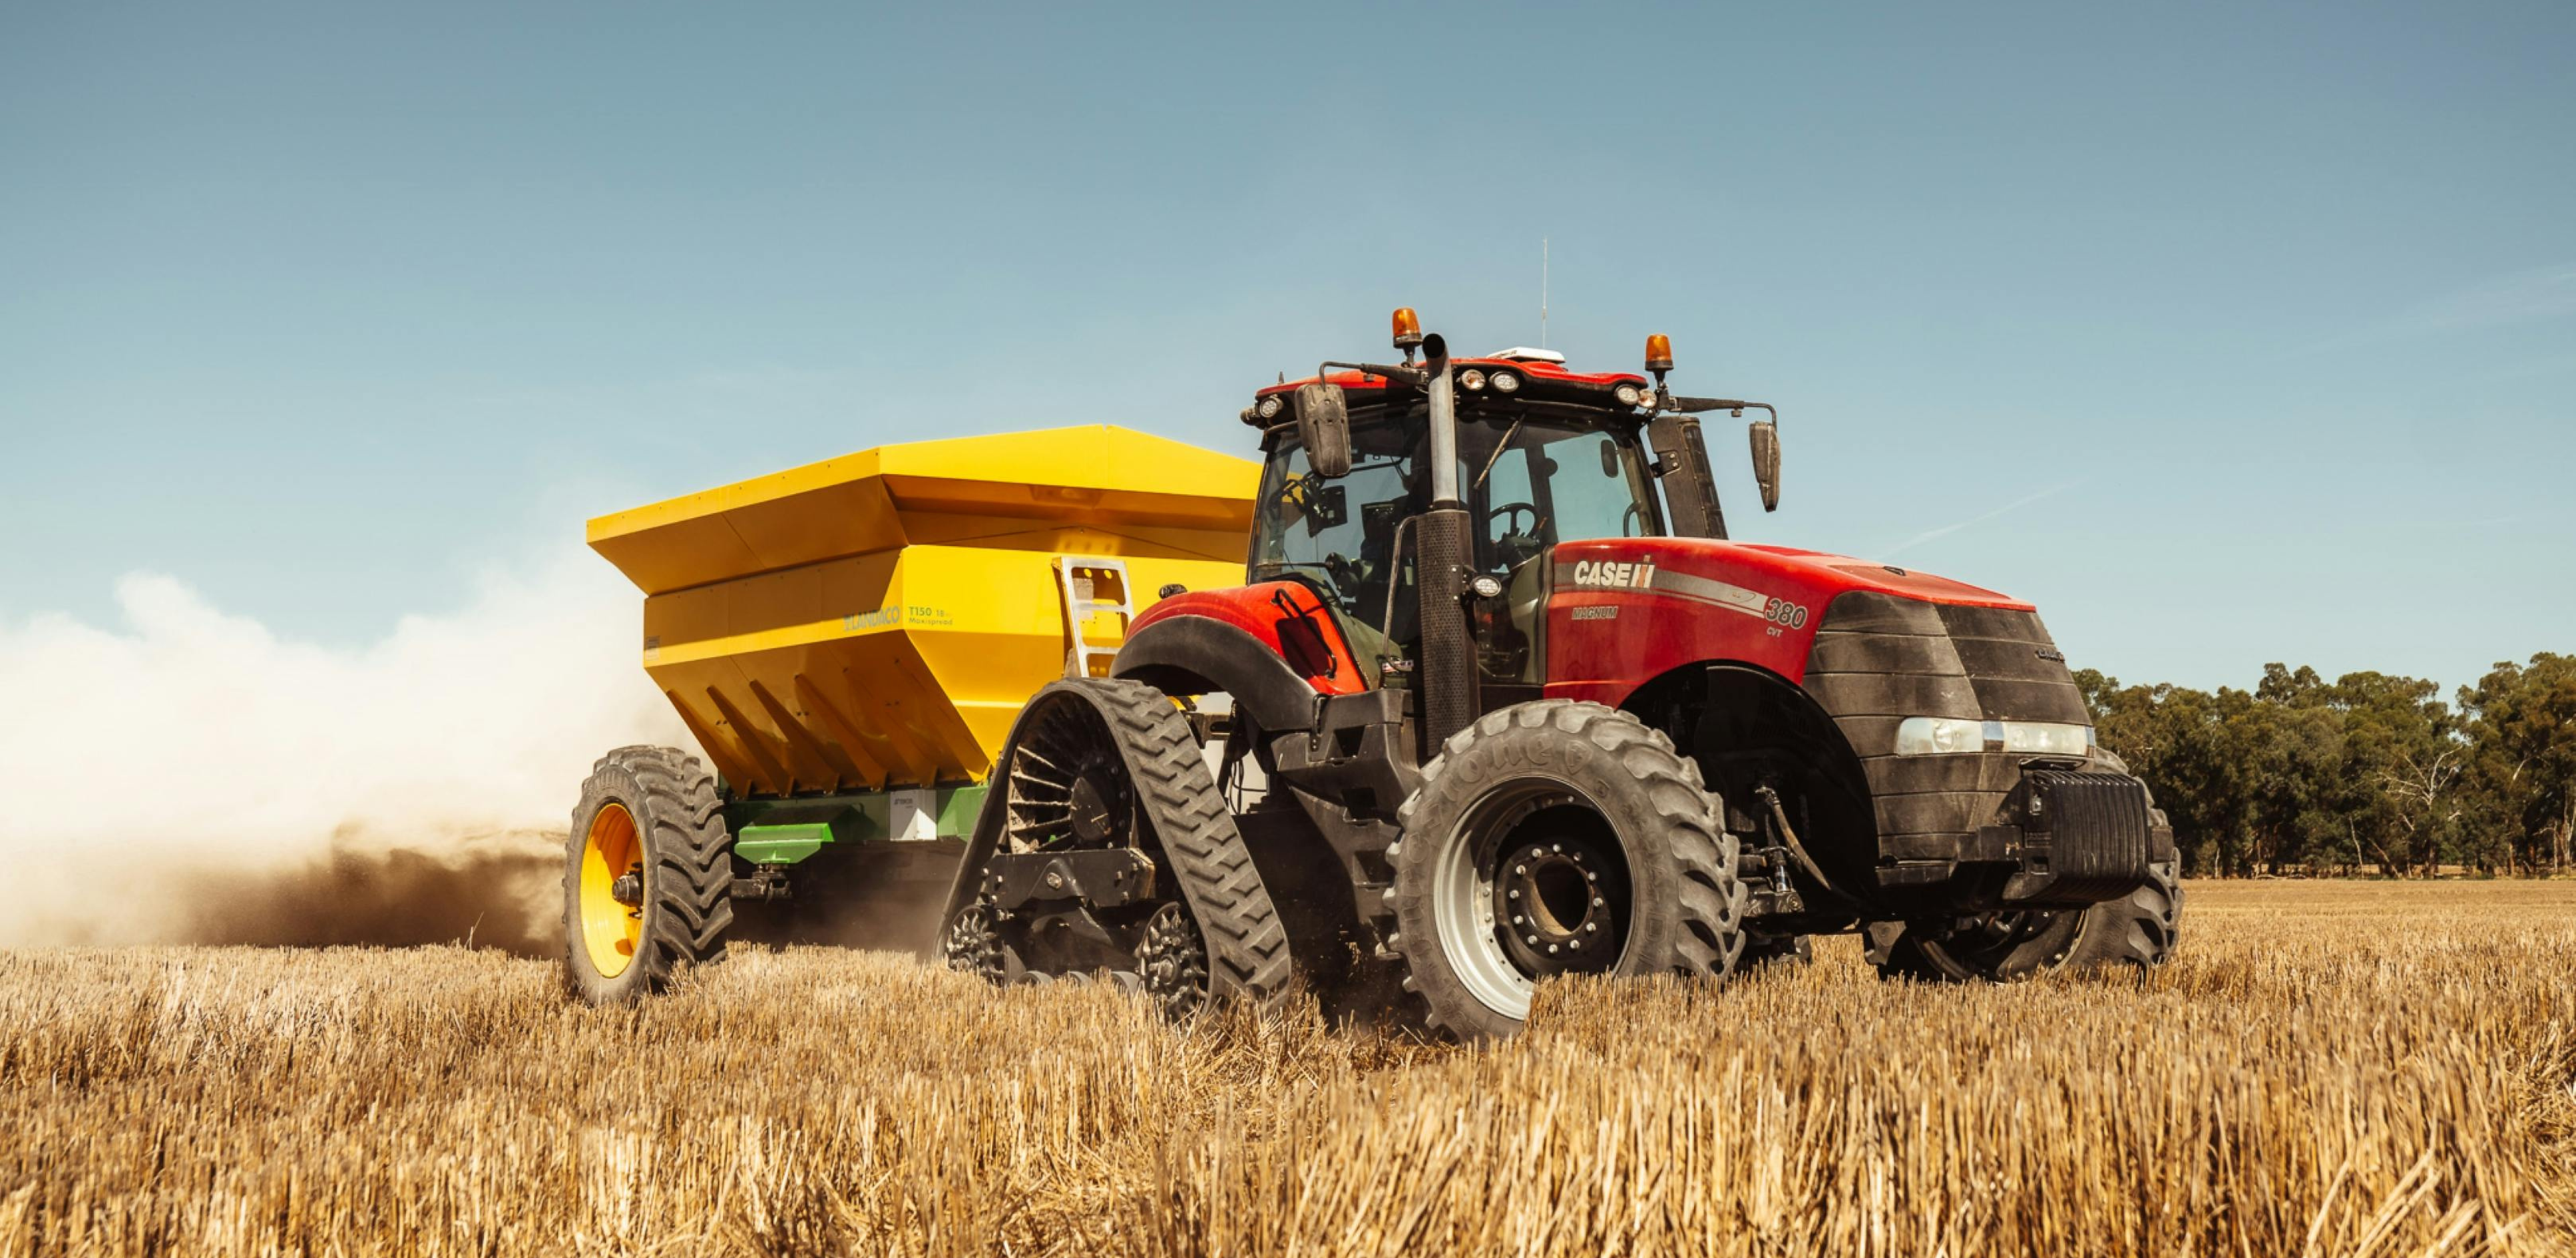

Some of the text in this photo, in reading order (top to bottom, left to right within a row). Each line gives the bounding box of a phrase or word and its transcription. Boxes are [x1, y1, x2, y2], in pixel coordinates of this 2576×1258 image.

[1574, 560, 1631, 586] CASE
[909, 606, 932, 616] T150
[1572, 606, 1619, 620] MAGNUM
[1765, 597, 1808, 630] 380
[851, 606, 900, 631] LANDACO
[909, 617, 953, 626] Maxispread
[1767, 626, 1783, 638] CVT
